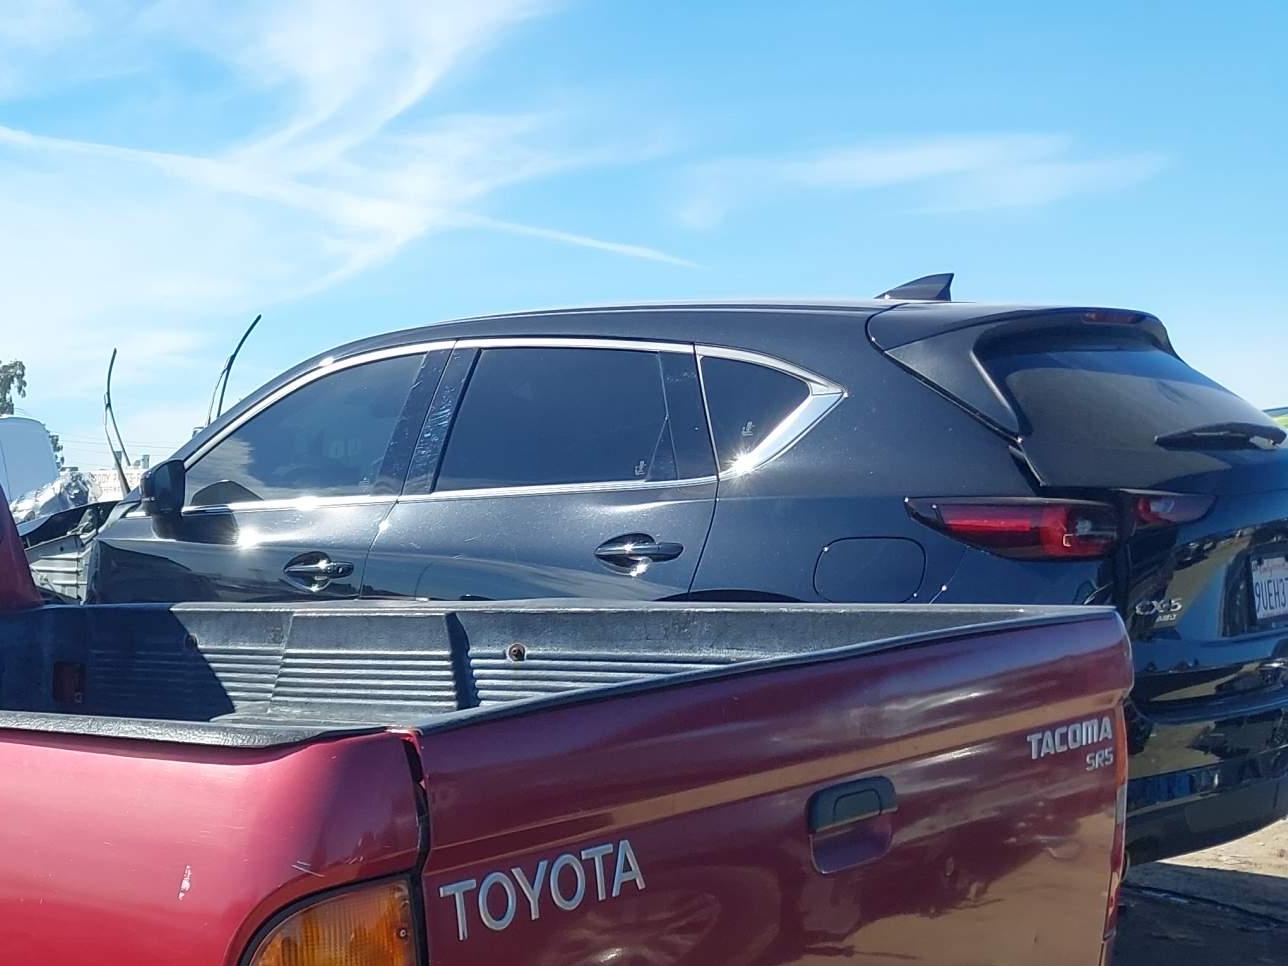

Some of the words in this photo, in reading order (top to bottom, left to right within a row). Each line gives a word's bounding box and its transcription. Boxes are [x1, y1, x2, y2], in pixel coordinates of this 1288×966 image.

[1135, 598, 1183, 615] CX-5
[1027, 716, 1113, 760] TACOMA
[1085, 747, 1113, 771] SR5
[439, 839, 646, 941] TOYOTA
